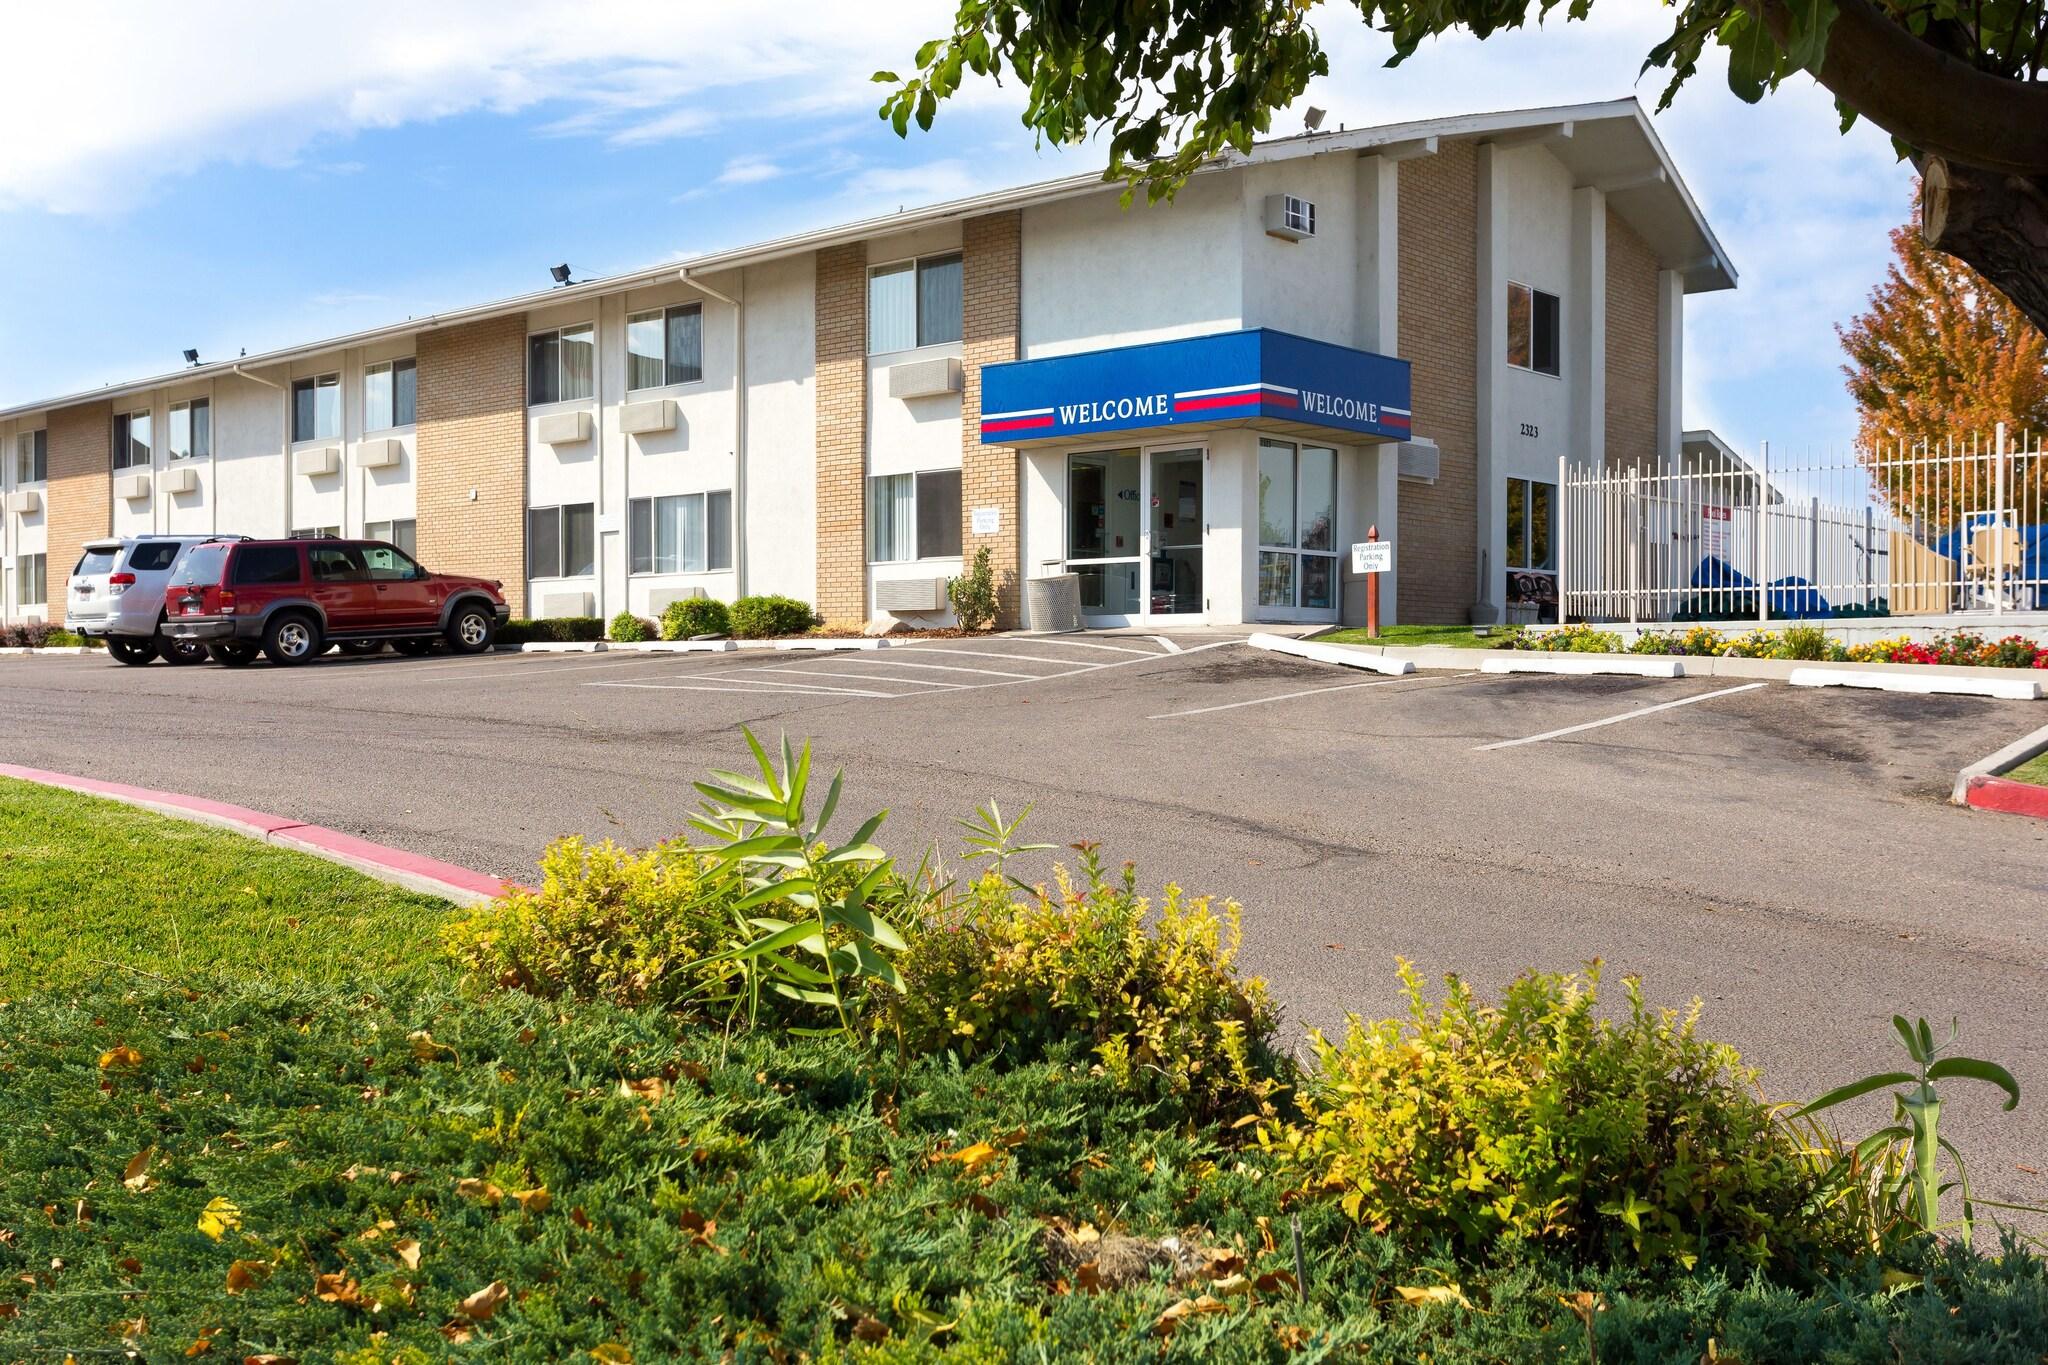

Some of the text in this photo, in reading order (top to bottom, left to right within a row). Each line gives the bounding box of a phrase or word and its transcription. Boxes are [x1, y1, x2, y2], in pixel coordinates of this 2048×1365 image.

[1059, 394, 1168, 425] WELCOME
[1302, 390, 1377, 423] WELCOME
[1520, 423, 1538, 438] 2323
[1353, 543, 1390, 552] Registration
[1360, 553, 1383, 561] Parking
[1363, 562, 1378, 570] Only
